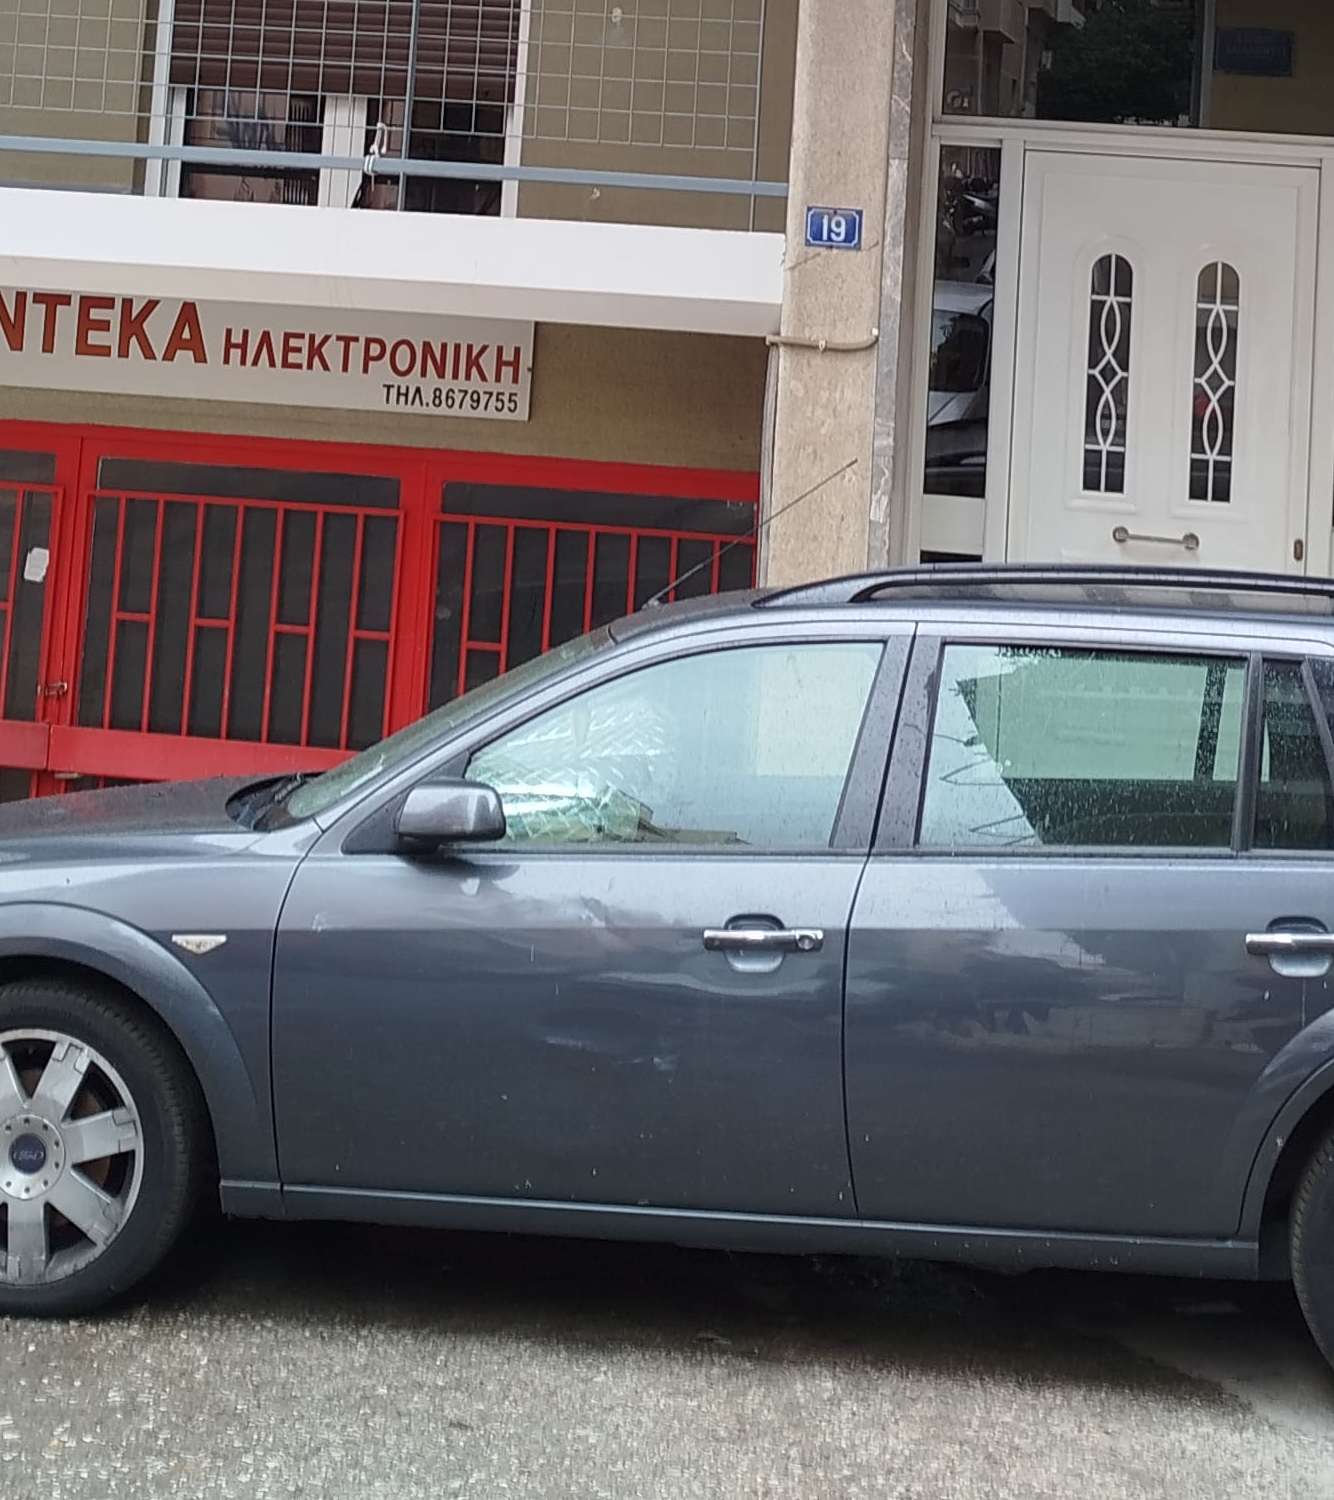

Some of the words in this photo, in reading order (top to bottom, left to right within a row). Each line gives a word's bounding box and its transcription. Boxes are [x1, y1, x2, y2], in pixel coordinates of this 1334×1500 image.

[822, 214, 846, 242] 19
[222, 327, 521, 385] ΗΛΕΚΤΡΟΝΙΚΗ
[382, 384, 518, 414] ΤΗΛ.8679755
